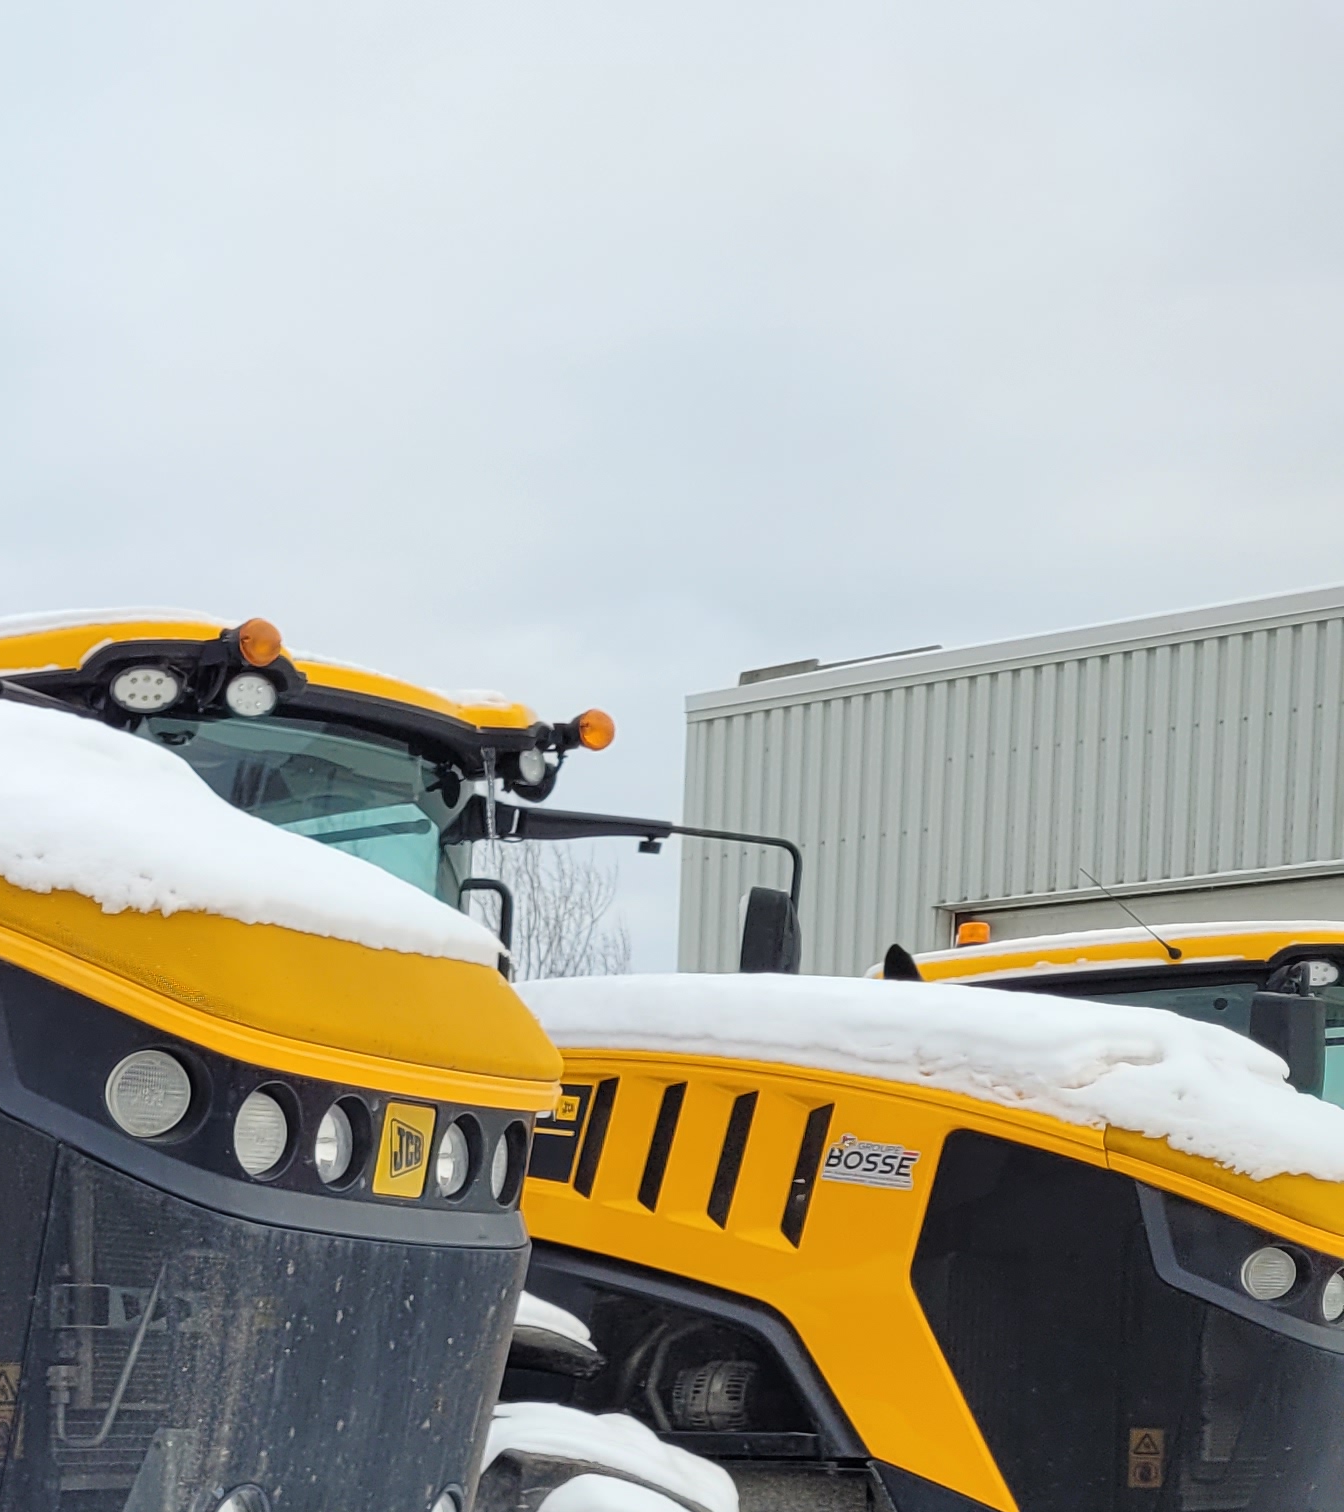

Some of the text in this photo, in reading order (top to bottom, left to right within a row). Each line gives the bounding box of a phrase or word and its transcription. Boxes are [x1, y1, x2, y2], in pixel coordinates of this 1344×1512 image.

[393, 1125, 422, 1172] JCB
[825, 1146, 917, 1177] BOSSE
[857, 1142, 903, 1154] GROUPE
